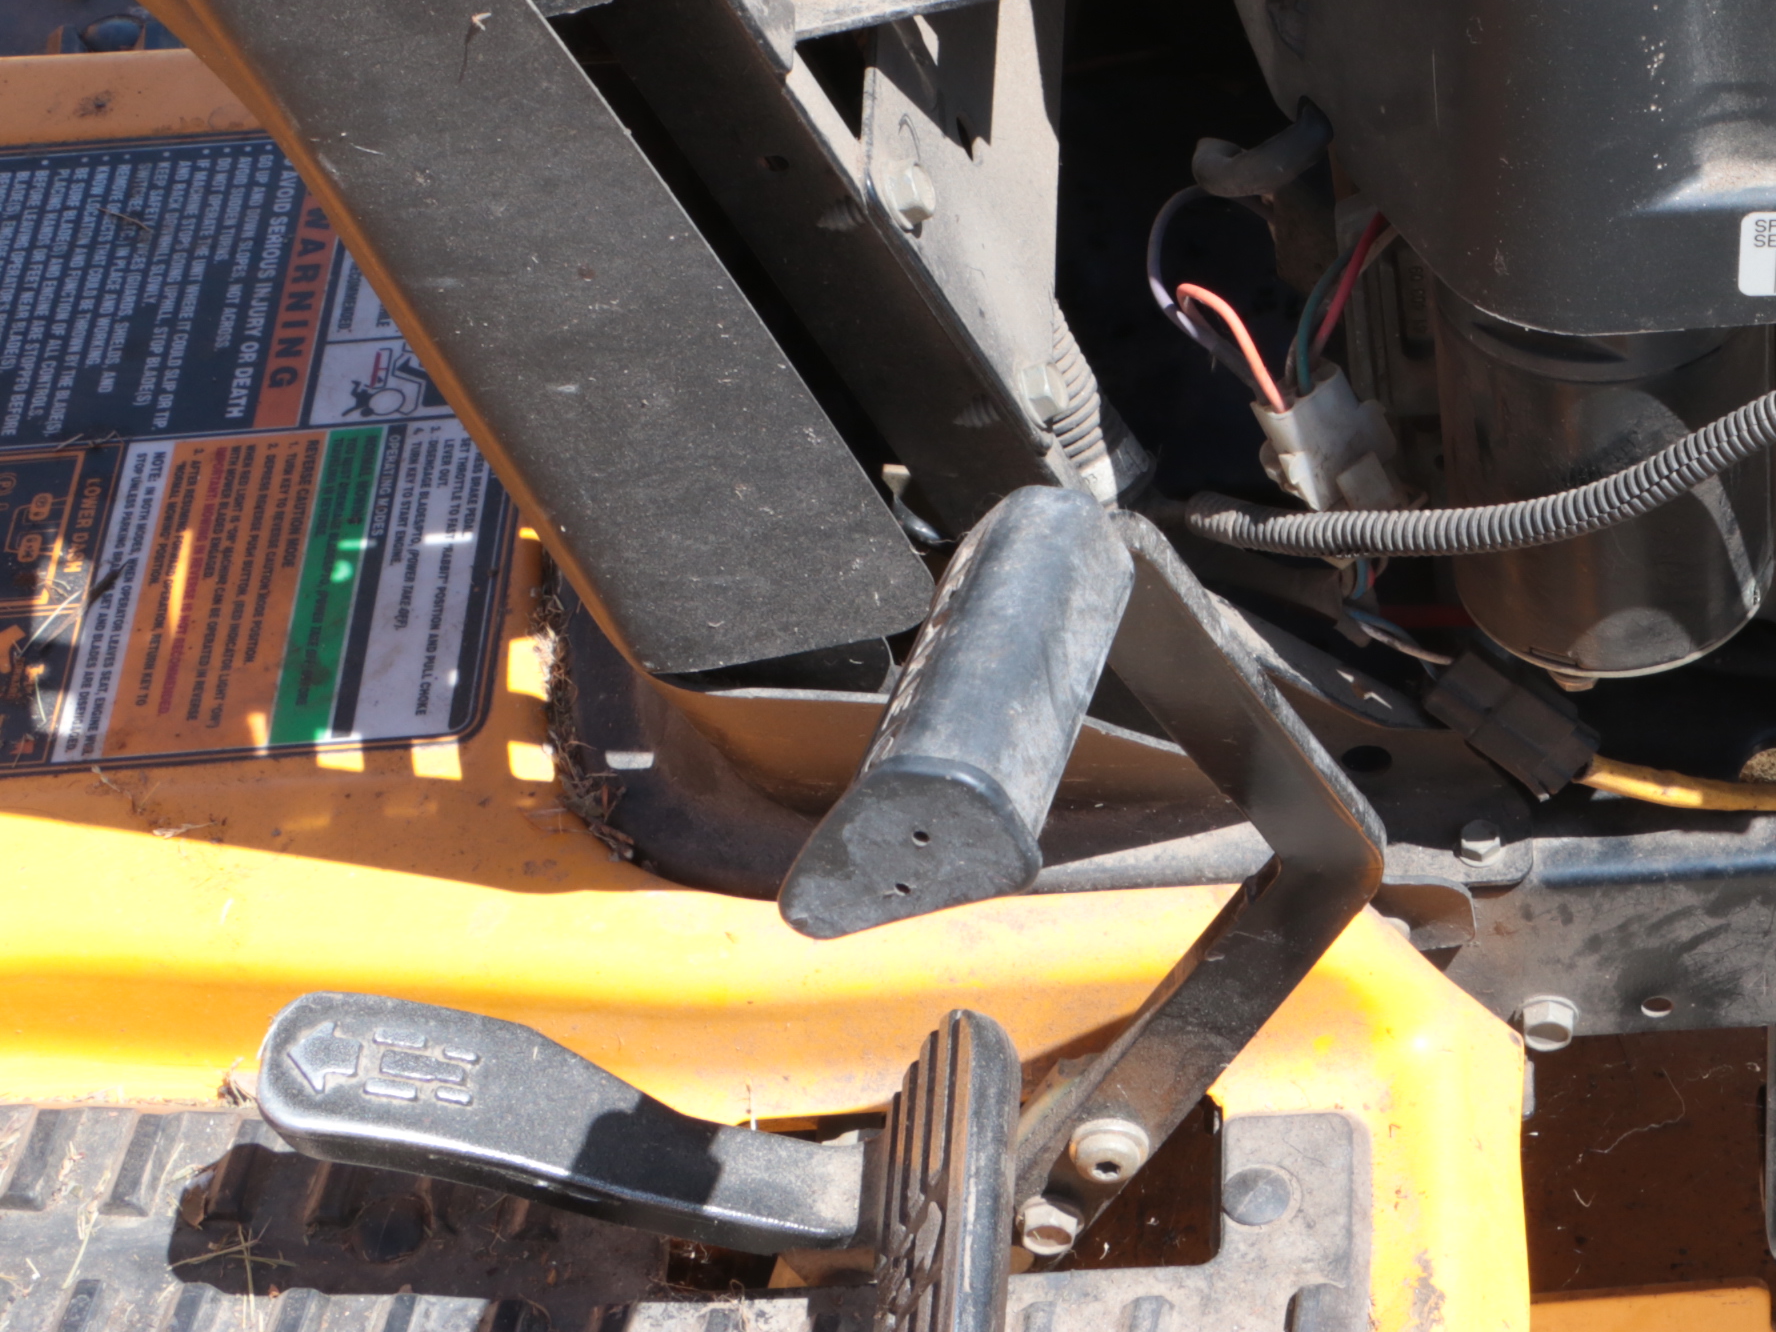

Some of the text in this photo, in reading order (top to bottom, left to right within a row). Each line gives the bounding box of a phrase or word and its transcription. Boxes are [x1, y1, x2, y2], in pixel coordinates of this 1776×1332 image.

[216, 157, 229, 170] DO
[233, 156, 250, 184] AVOID
[258, 154, 271, 167] GO
[210, 173, 225, 190] NOT
[254, 170, 268, 183] UP
[223, 187, 243, 225] SUDDEN
[248, 186, 264, 206] AND
[200, 193, 220, 236] OPERATE
[241, 208, 258, 237] DOWN
[194, 238, 210, 256] THE
[188, 259, 204, 280] UNIT
[179, 283, 199, 318] WHERE
[224, 284, 241, 303] NOT
[225, 170, 297, 418] AVOID SERIOUS INJURY OR DEATH
[267, 206, 330, 389] WARNING
[176, 321, 189, 330] IT
[167, 333, 186, 366] COULD
[162, 369, 178, 390] SLIP
[157, 393, 172, 408] OR
[370, 434, 401, 536] OPERATING MODES
[76, 478, 103, 528] LOWER
[281, 439, 319, 568] REVERSE CAUTION MODE
